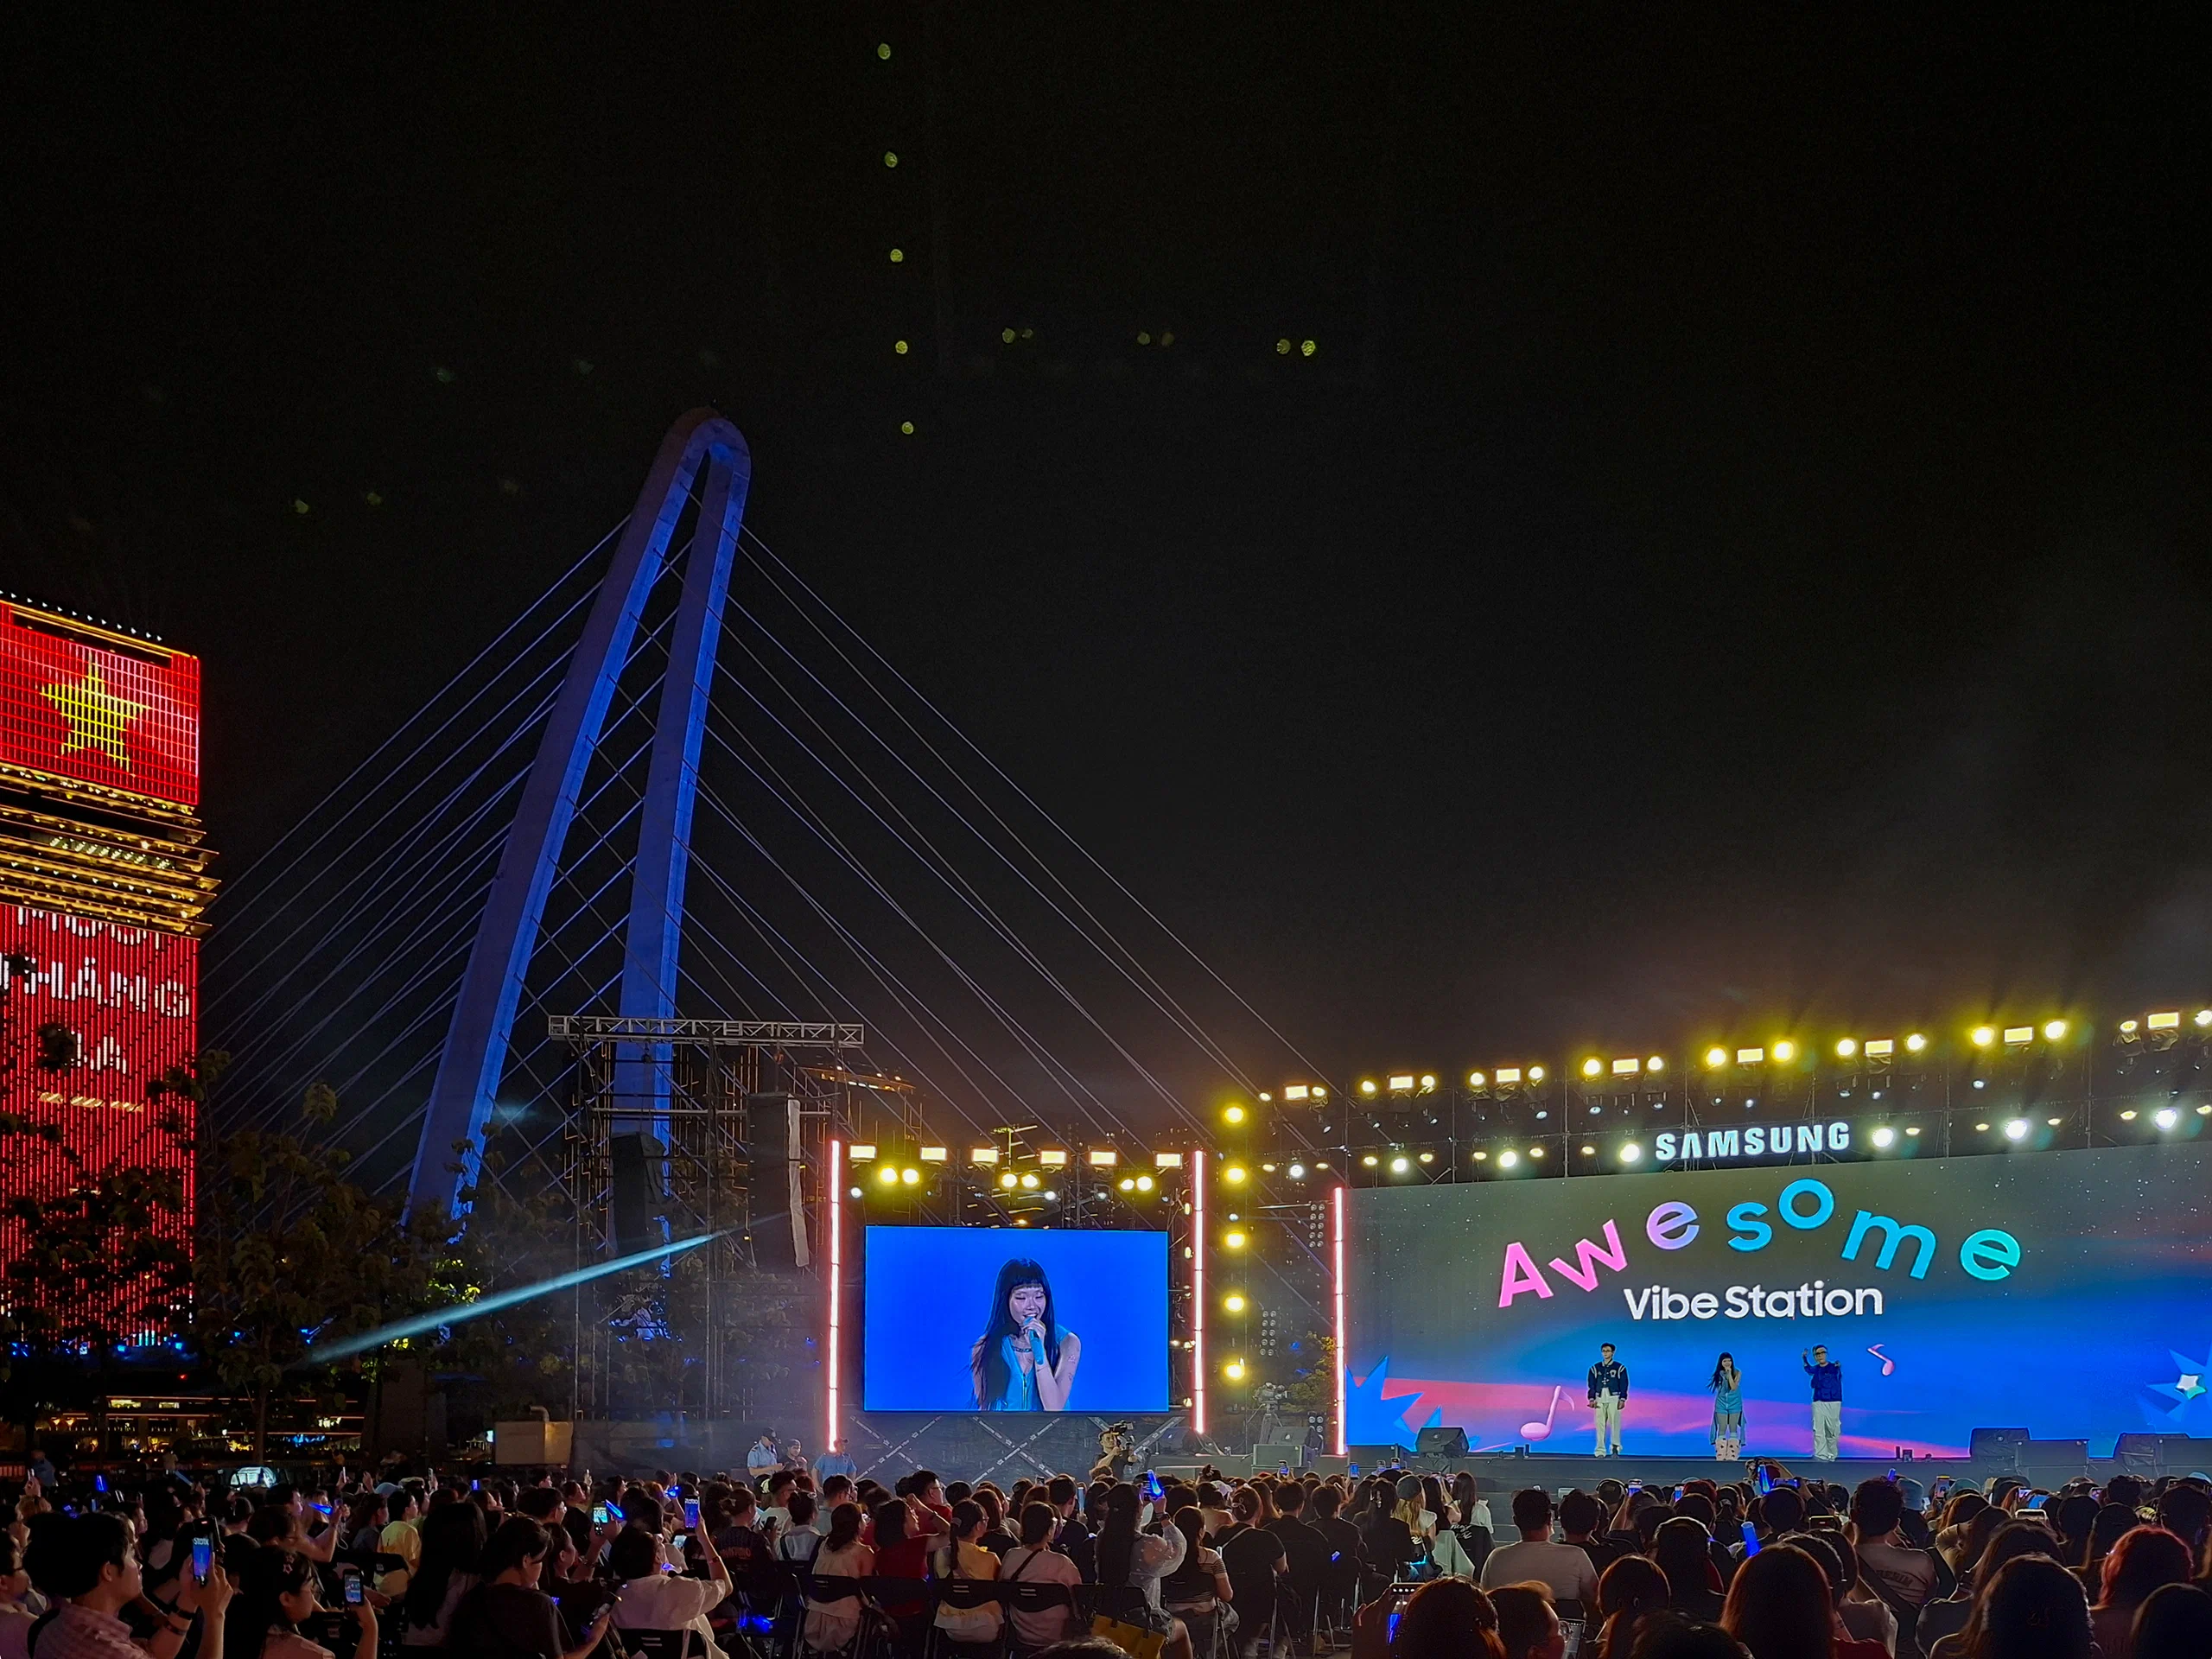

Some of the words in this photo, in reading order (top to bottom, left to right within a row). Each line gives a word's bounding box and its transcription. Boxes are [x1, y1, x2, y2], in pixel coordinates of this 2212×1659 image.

[1656, 1122, 1850, 1161] SAMSUNG
[1498, 1178, 2021, 1308] Awesome
[1624, 1286, 1719, 1321] Vibe
[1725, 1281, 1884, 1319] Station
